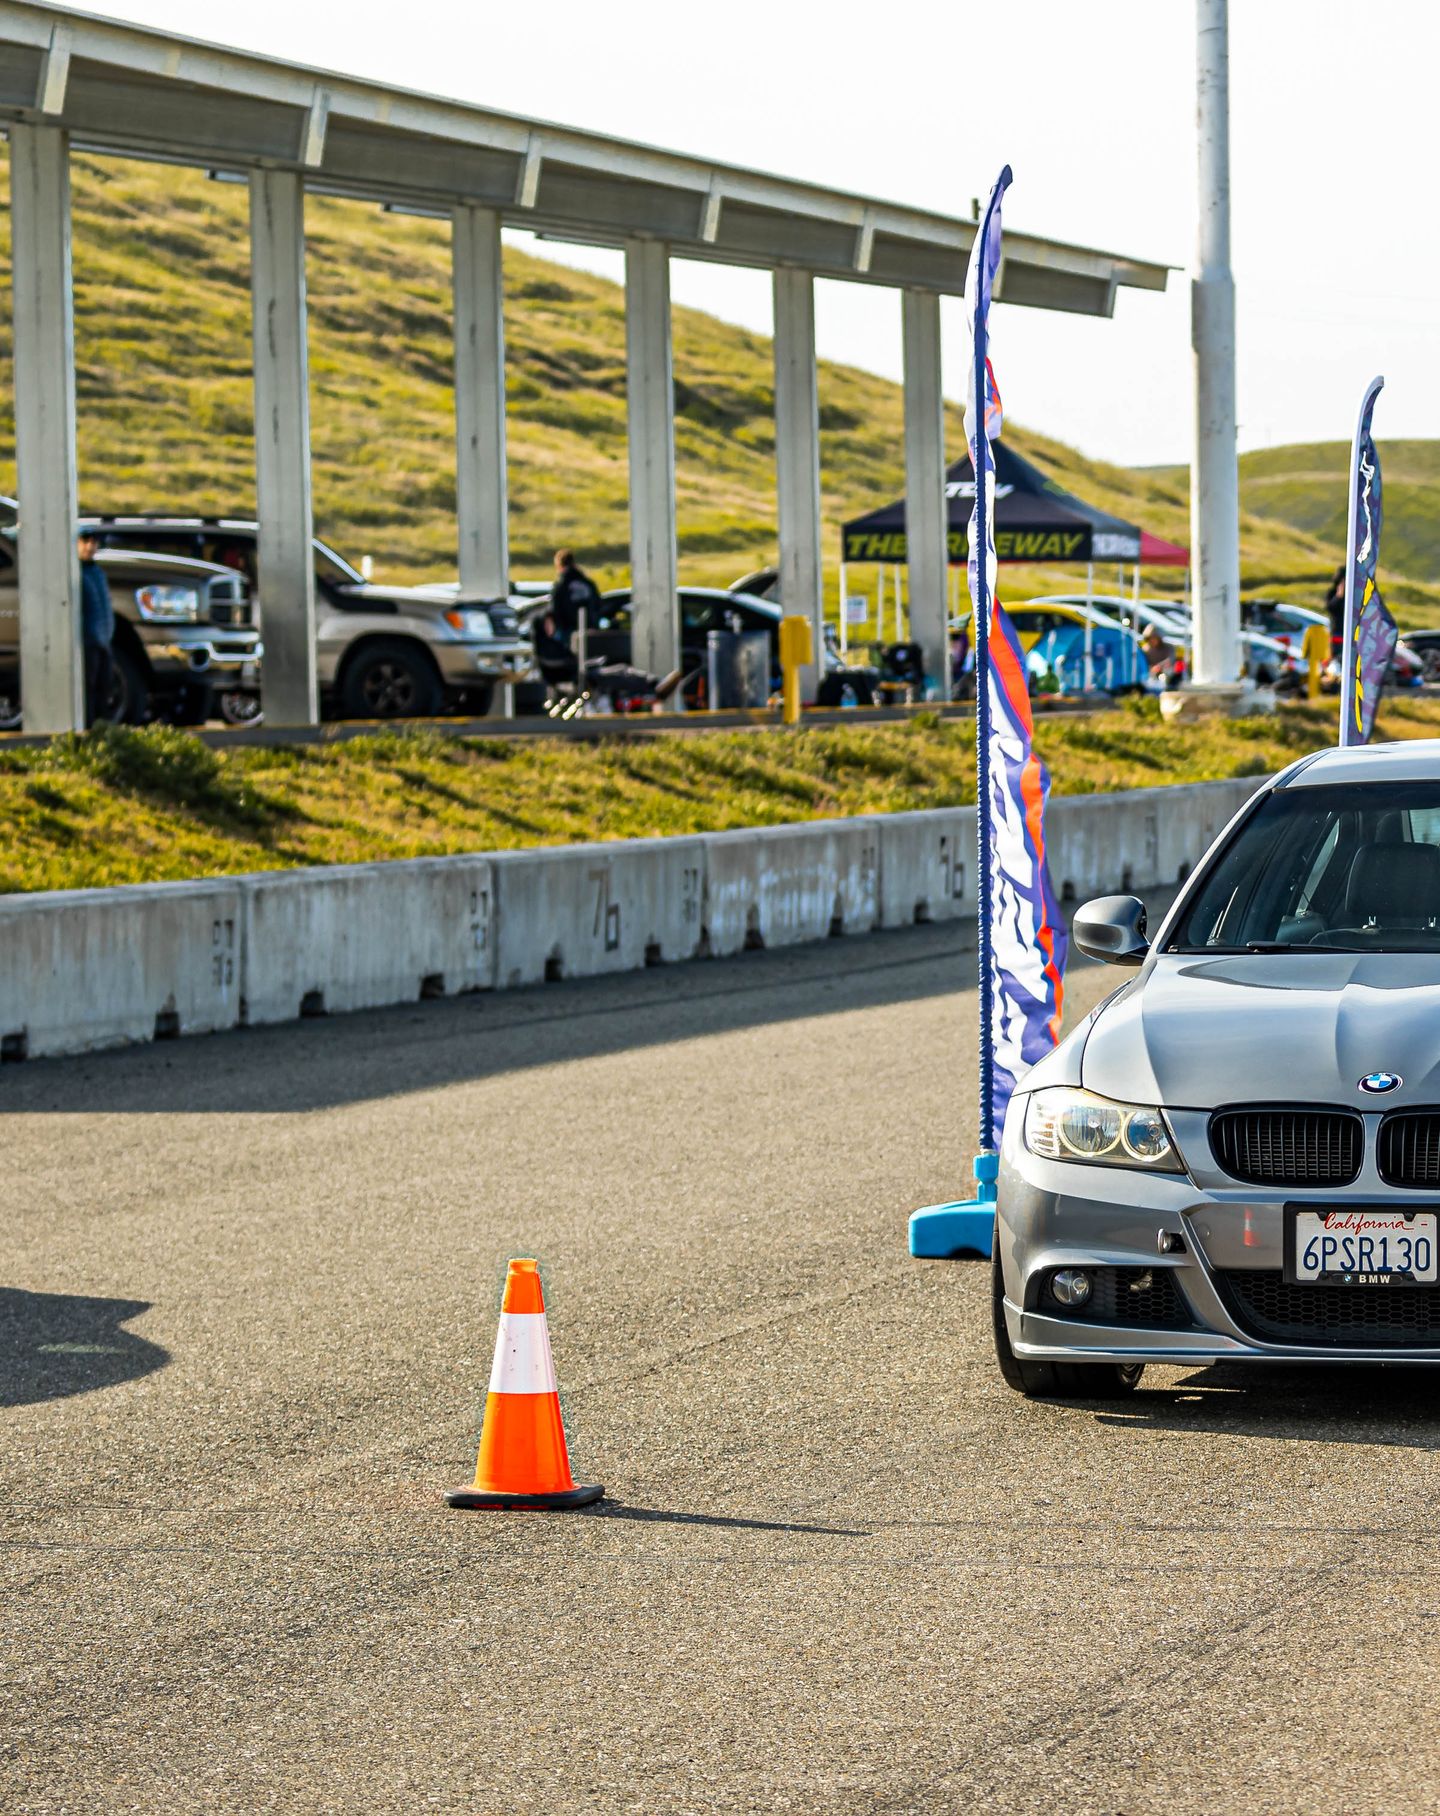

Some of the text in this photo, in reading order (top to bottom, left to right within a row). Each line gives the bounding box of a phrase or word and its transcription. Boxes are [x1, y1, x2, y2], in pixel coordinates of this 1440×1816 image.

[1323, 1211, 1414, 1236] California
[1302, 1235, 1431, 1273] 6PSR130
[1358, 1274, 1391, 1284] BMW
